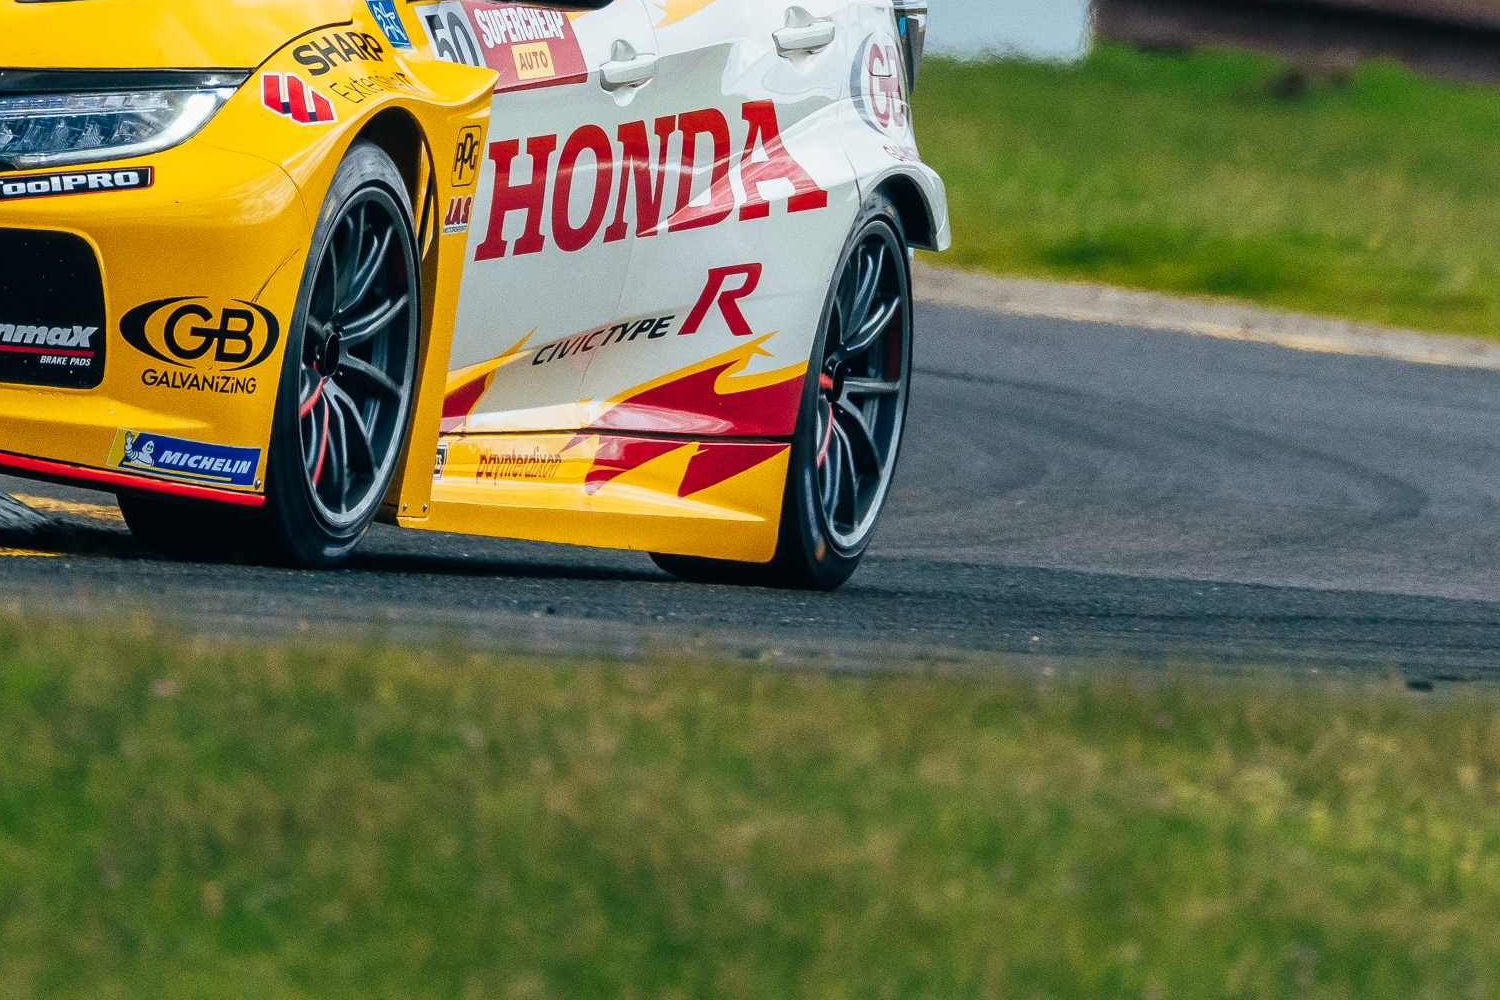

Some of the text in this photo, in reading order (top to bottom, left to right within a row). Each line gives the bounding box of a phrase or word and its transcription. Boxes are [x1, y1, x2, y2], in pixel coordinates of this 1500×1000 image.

[425, 11, 480, 67] 50
[474, 6, 565, 49] SUPERCHEAP
[293, 31, 383, 76] SHARP
[519, 50, 549, 72] AUTO
[474, 98, 828, 262] HONDA
[163, 303, 255, 363] GB
[531, 262, 762, 366] CIVIC TYPE R
[39, 355, 92, 367] BRAKE PADS
[158, 449, 251, 475] MICHELIN
